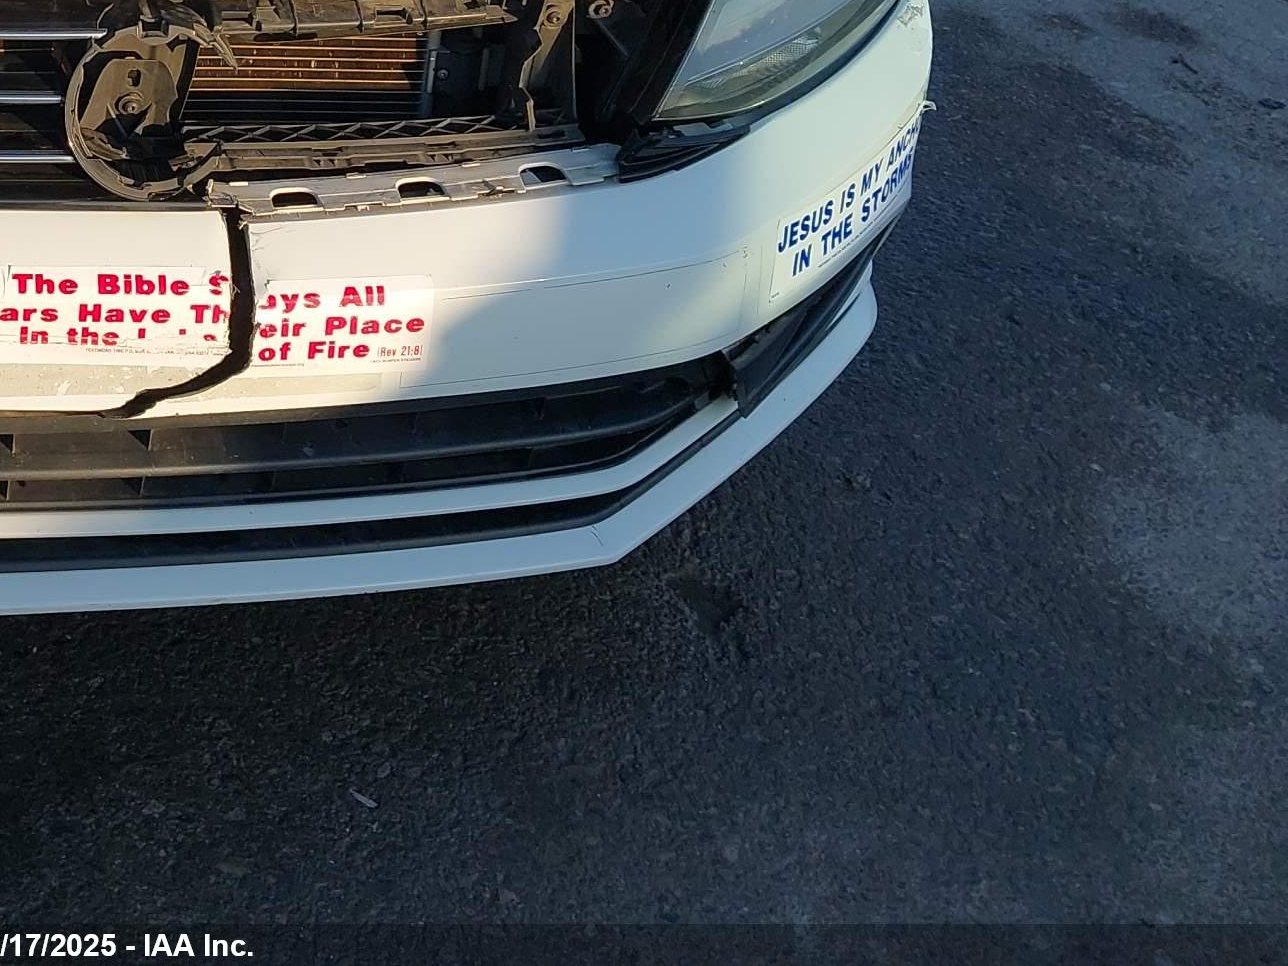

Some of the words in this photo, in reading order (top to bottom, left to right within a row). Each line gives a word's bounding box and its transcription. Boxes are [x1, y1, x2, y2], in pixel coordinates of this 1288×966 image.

[777, 200, 834, 253] JESUS
[840, 183, 856, 214] IS
[860, 157, 884, 196] MY
[792, 244, 812, 277] IN
[821, 213, 854, 256] THE
[12, 273, 79, 295] The
[97, 273, 190, 296] Bible
[340, 284, 385, 307] All
[78, 303, 171, 324] Have
[324, 315, 426, 337] Place
[19, 326, 49, 345] In
[67, 327, 120, 346] the
[258, 342, 292, 362] of
[307, 341, 370, 361] Fire
